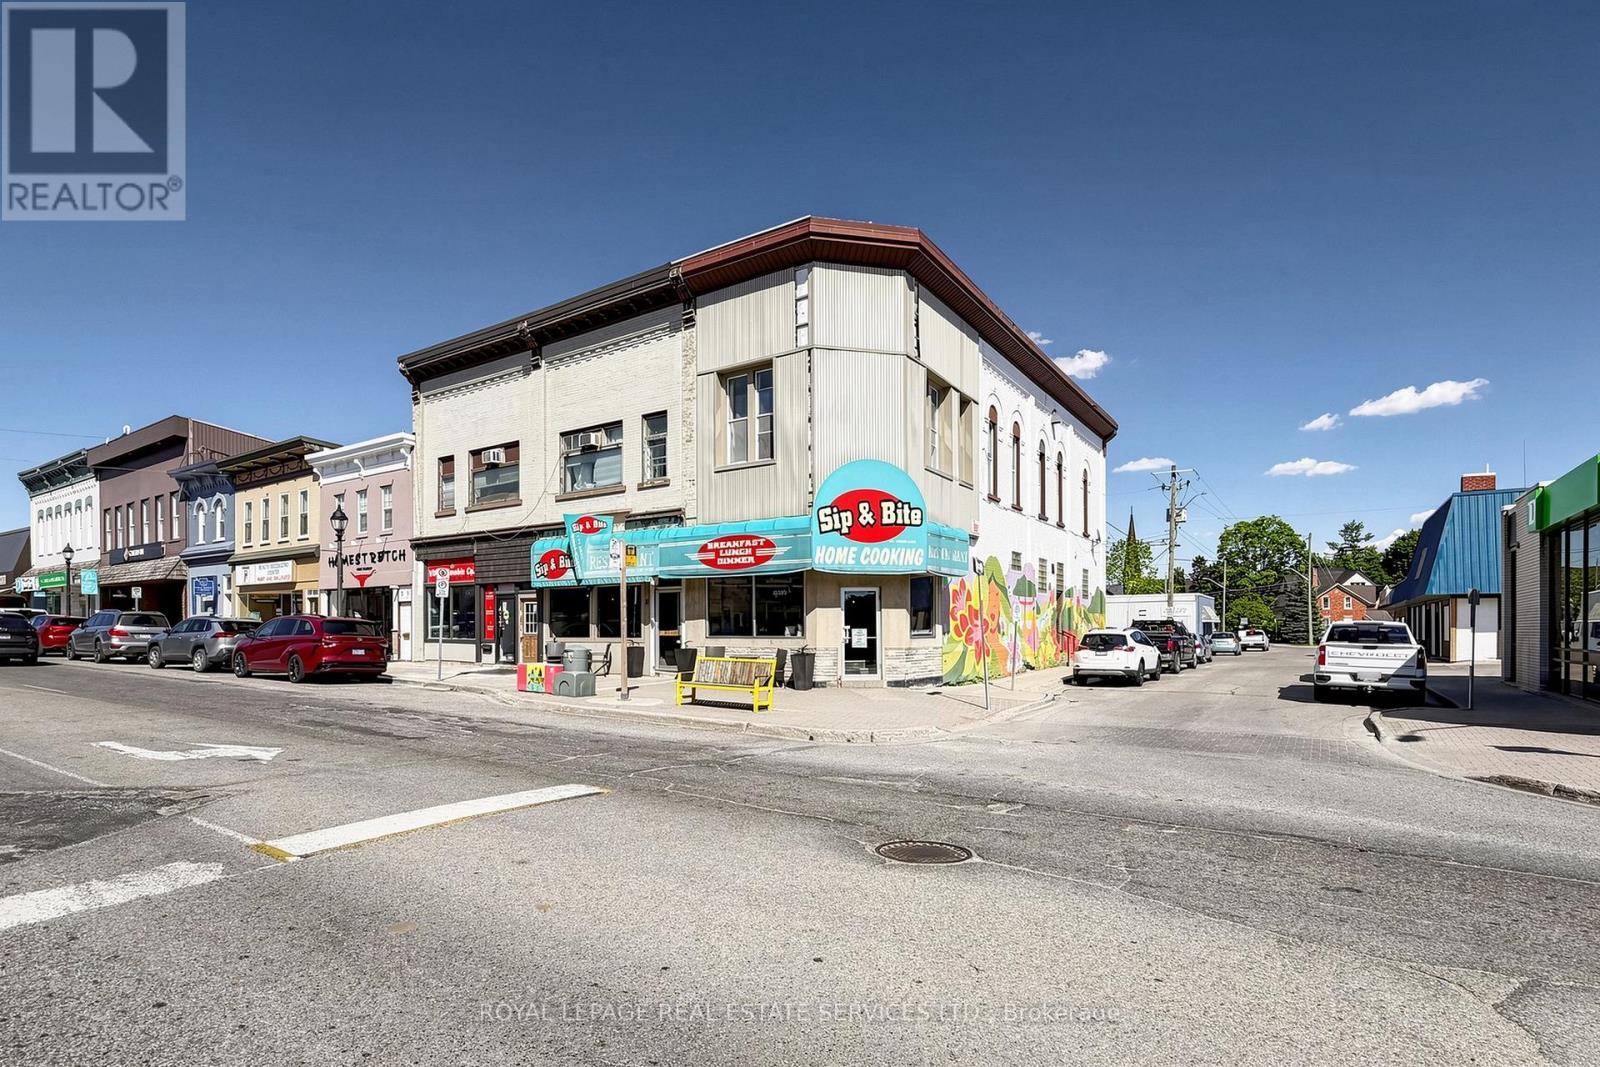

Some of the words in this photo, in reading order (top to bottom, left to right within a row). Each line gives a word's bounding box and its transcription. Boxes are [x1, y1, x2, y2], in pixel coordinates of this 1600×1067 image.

[818, 506, 853, 535] Sip
[858, 501, 875, 527] &
[880, 500, 922, 526] Bite
[707, 539, 766, 549] BREAKFAST
[720, 548, 752, 556] LUNCH
[815, 546, 856, 565] HOME
[860, 547, 923, 566] COOKING
[535, 562, 549, 577] Sip
[550, 557, 557, 571] &
[559, 554, 573, 568] Bit
[717, 556, 756, 565] DINNER
